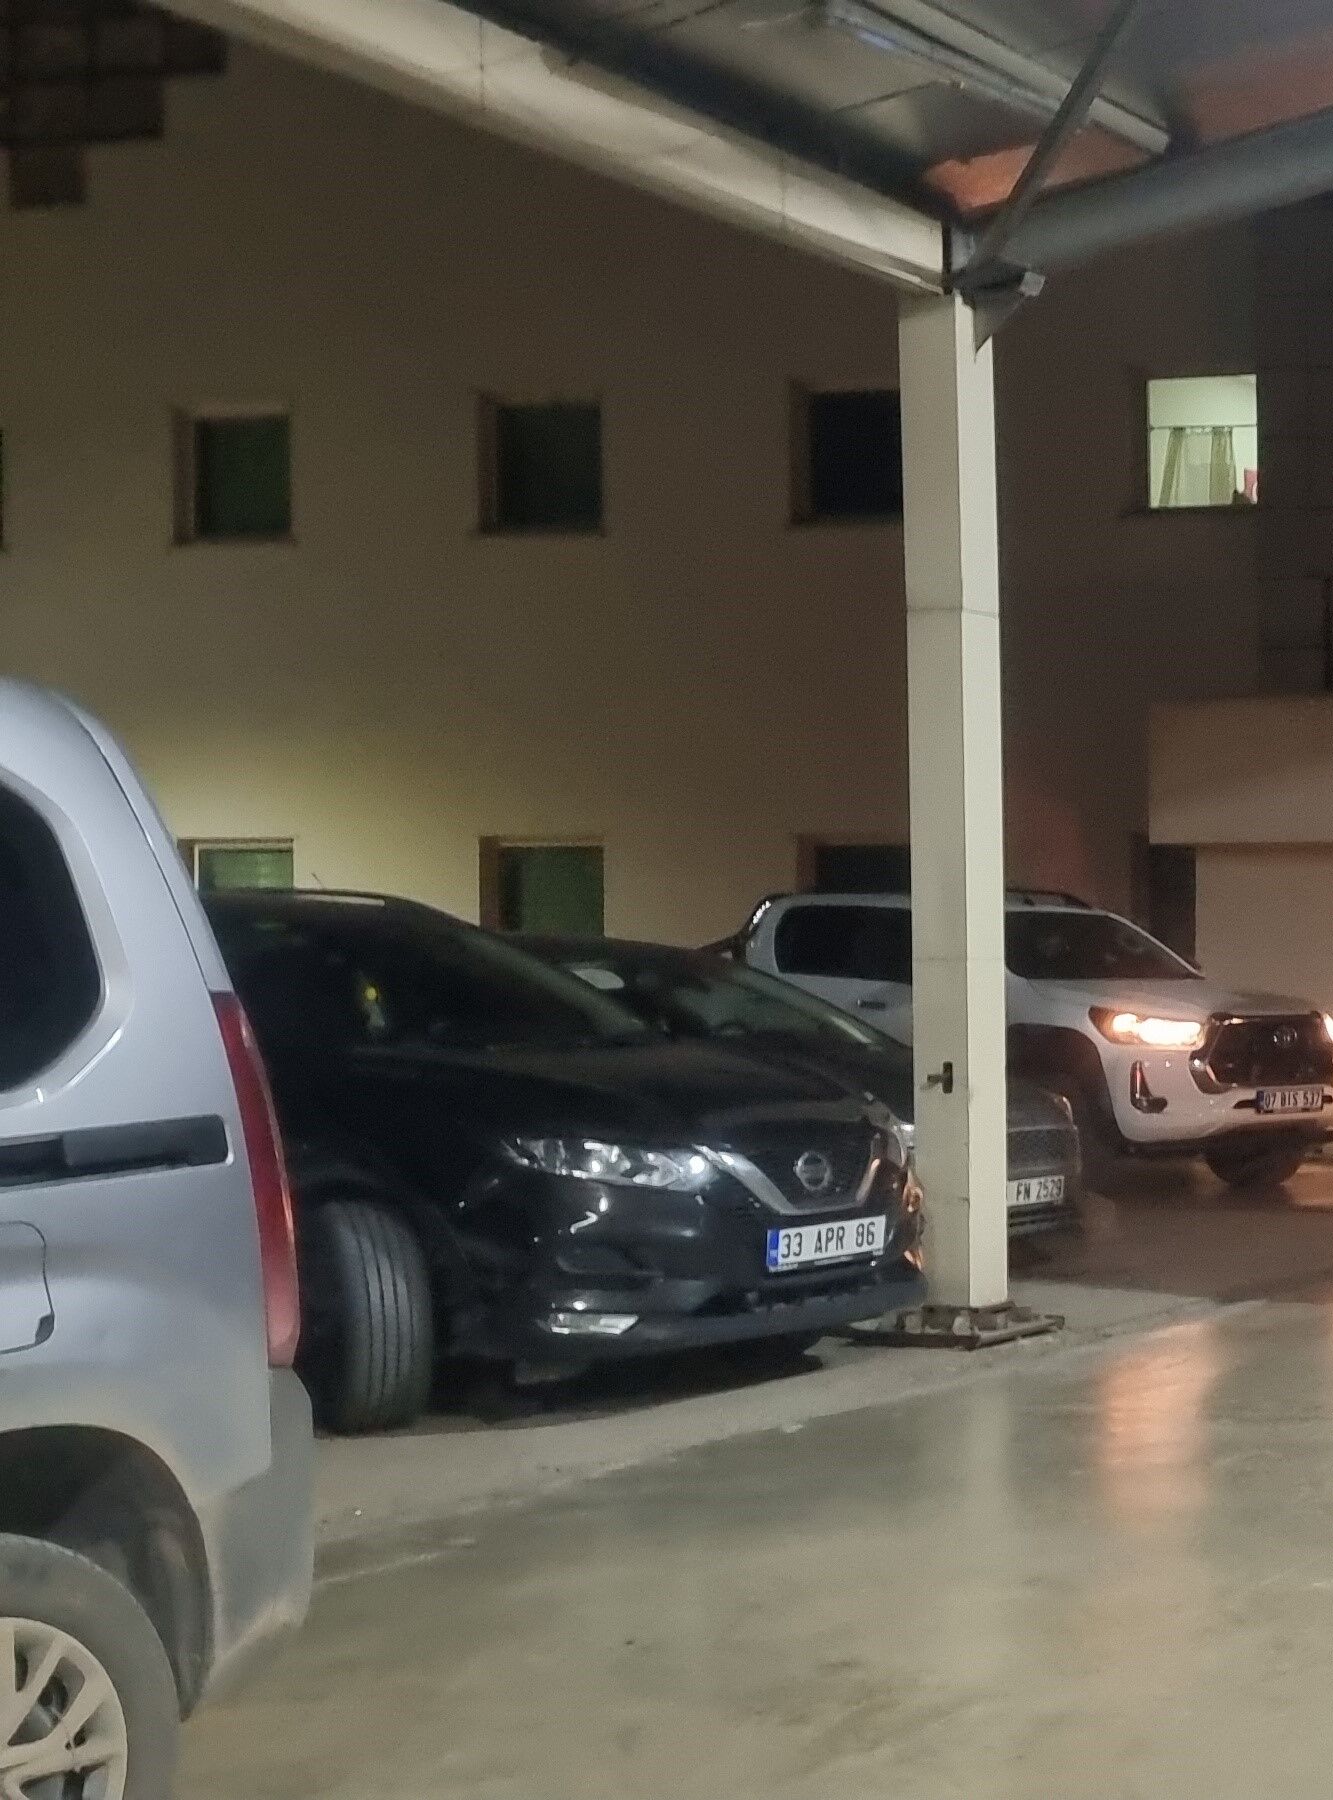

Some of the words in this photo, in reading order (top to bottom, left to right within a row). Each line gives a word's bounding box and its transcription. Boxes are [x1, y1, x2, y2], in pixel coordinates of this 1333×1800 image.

[781, 1232, 803, 1259] 33
[814, 1224, 845, 1254] APR
[855, 1220, 876, 1248] 86
